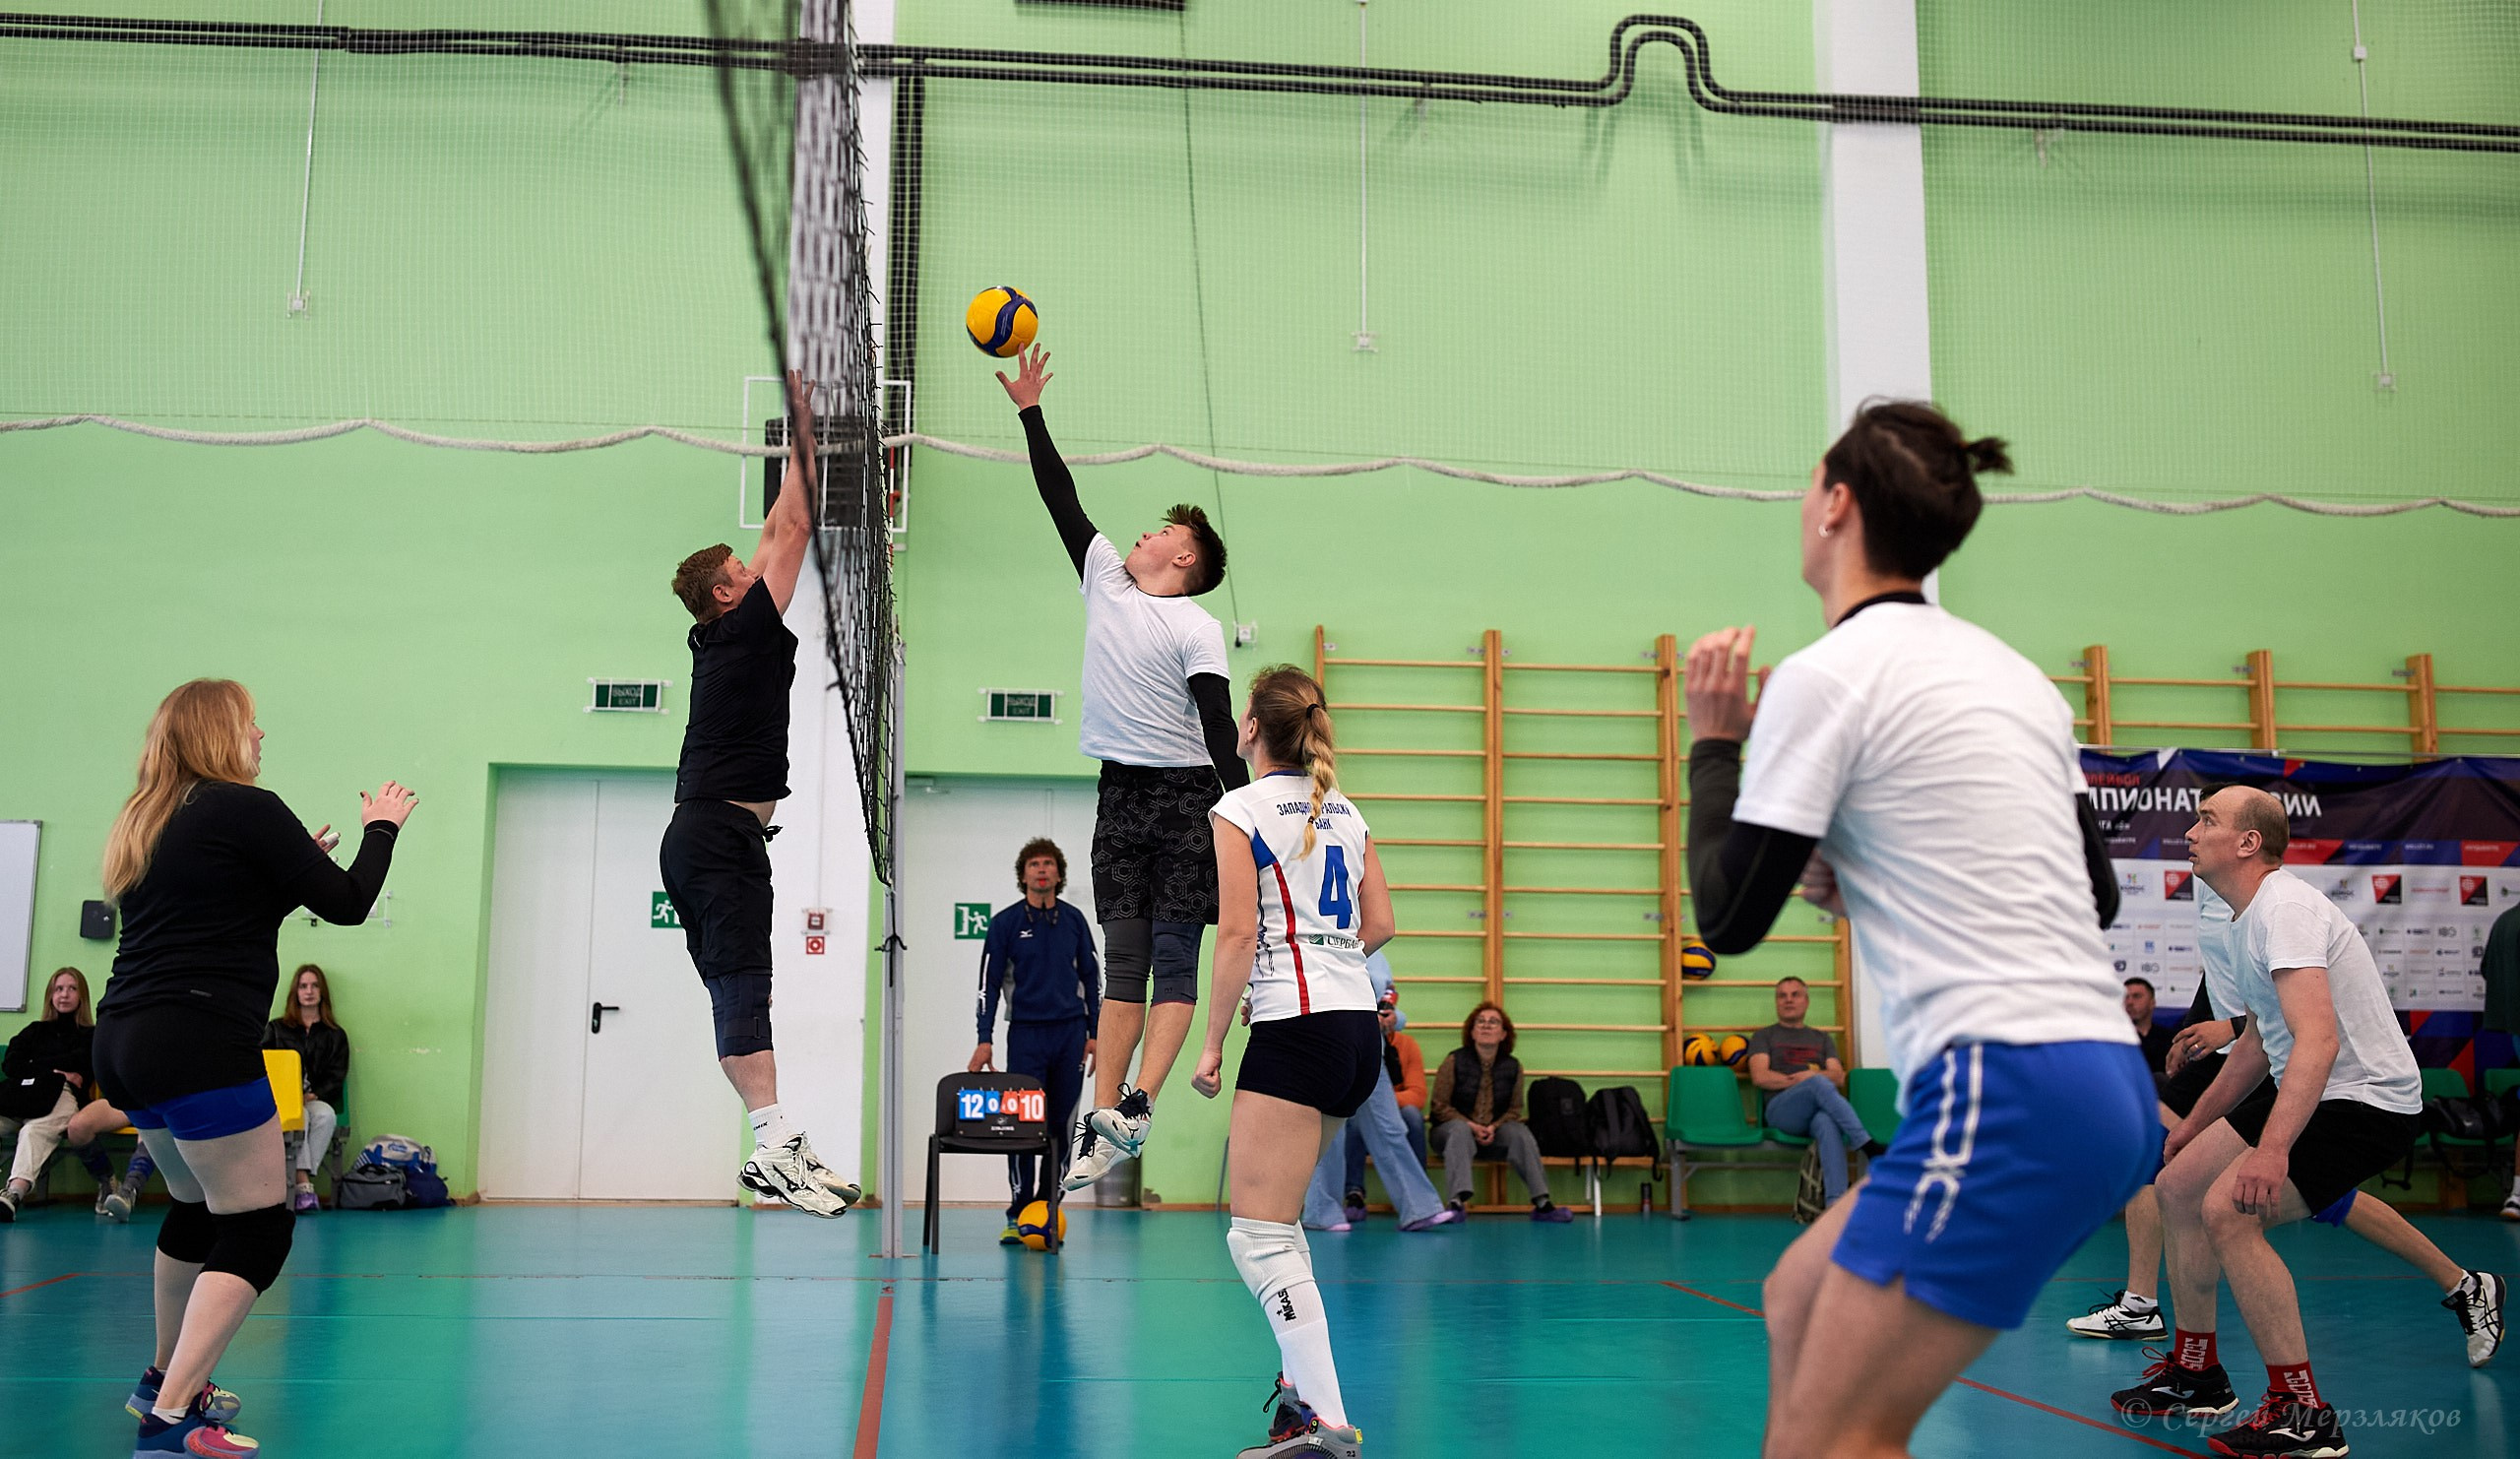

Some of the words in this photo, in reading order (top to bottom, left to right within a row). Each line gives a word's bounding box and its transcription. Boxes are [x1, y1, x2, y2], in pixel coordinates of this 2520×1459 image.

[1318, 845, 1353, 929] 4
[961, 1094, 983, 1118] 12
[988, 1098, 999, 1111] 0
[1007, 1098, 1018, 1112] 0
[1021, 1095, 1044, 1119] 10
